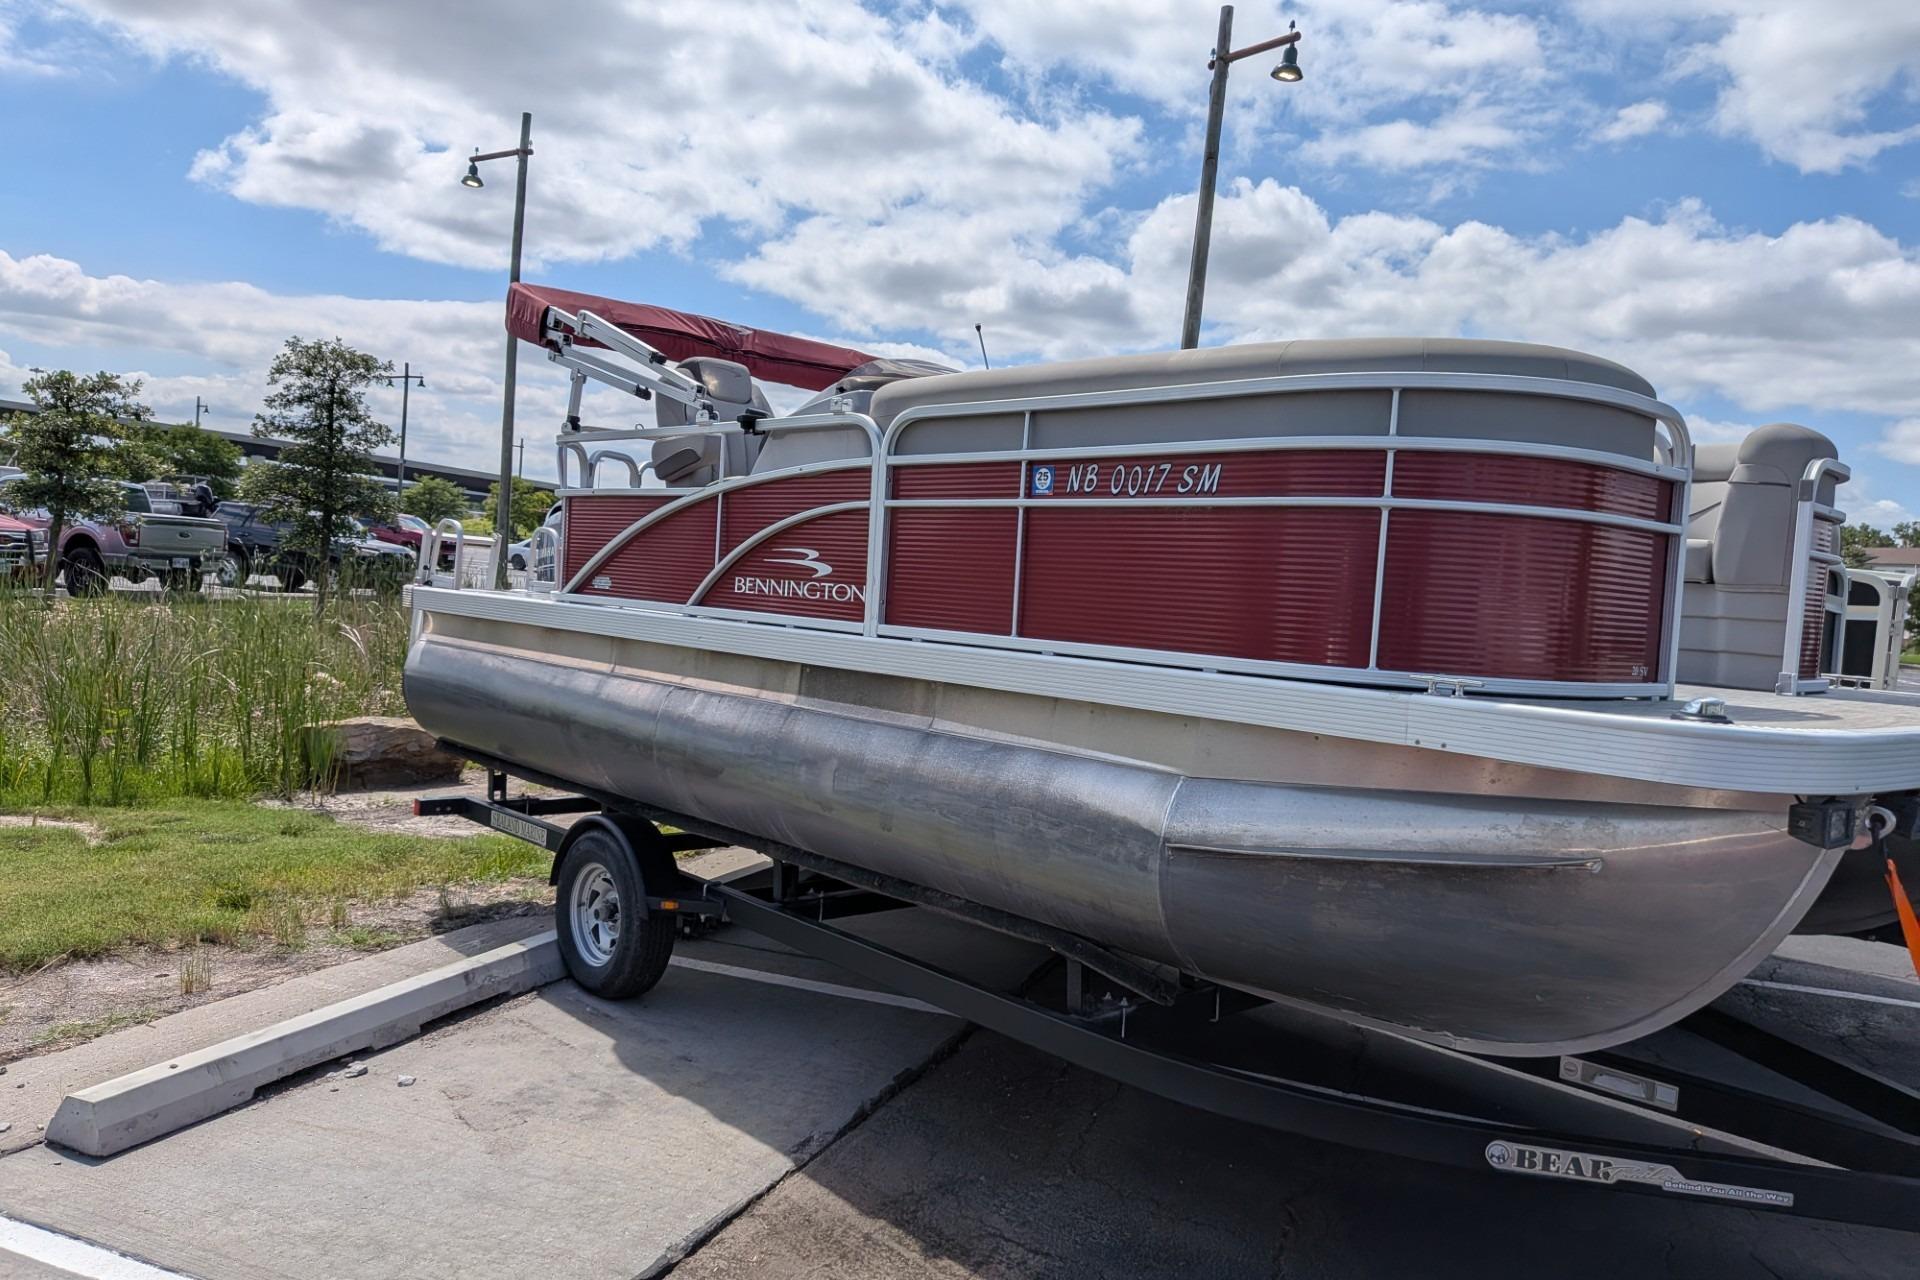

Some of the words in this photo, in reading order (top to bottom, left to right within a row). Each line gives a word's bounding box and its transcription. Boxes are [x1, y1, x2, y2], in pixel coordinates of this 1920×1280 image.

[1037, 471, 1049, 482] 25
[1066, 463, 1099, 493] NB
[1110, 464, 1172, 496] 0017
[1177, 463, 1222, 494] SM
[734, 576, 866, 603] BENNINGTON
[1513, 1147, 1614, 1181] BEAR
[1664, 1180, 1702, 1192] Behind
[1704, 1185, 1726, 1196] You
[1727, 1188, 1744, 1197] All
[1745, 1190, 1764, 1199] the
